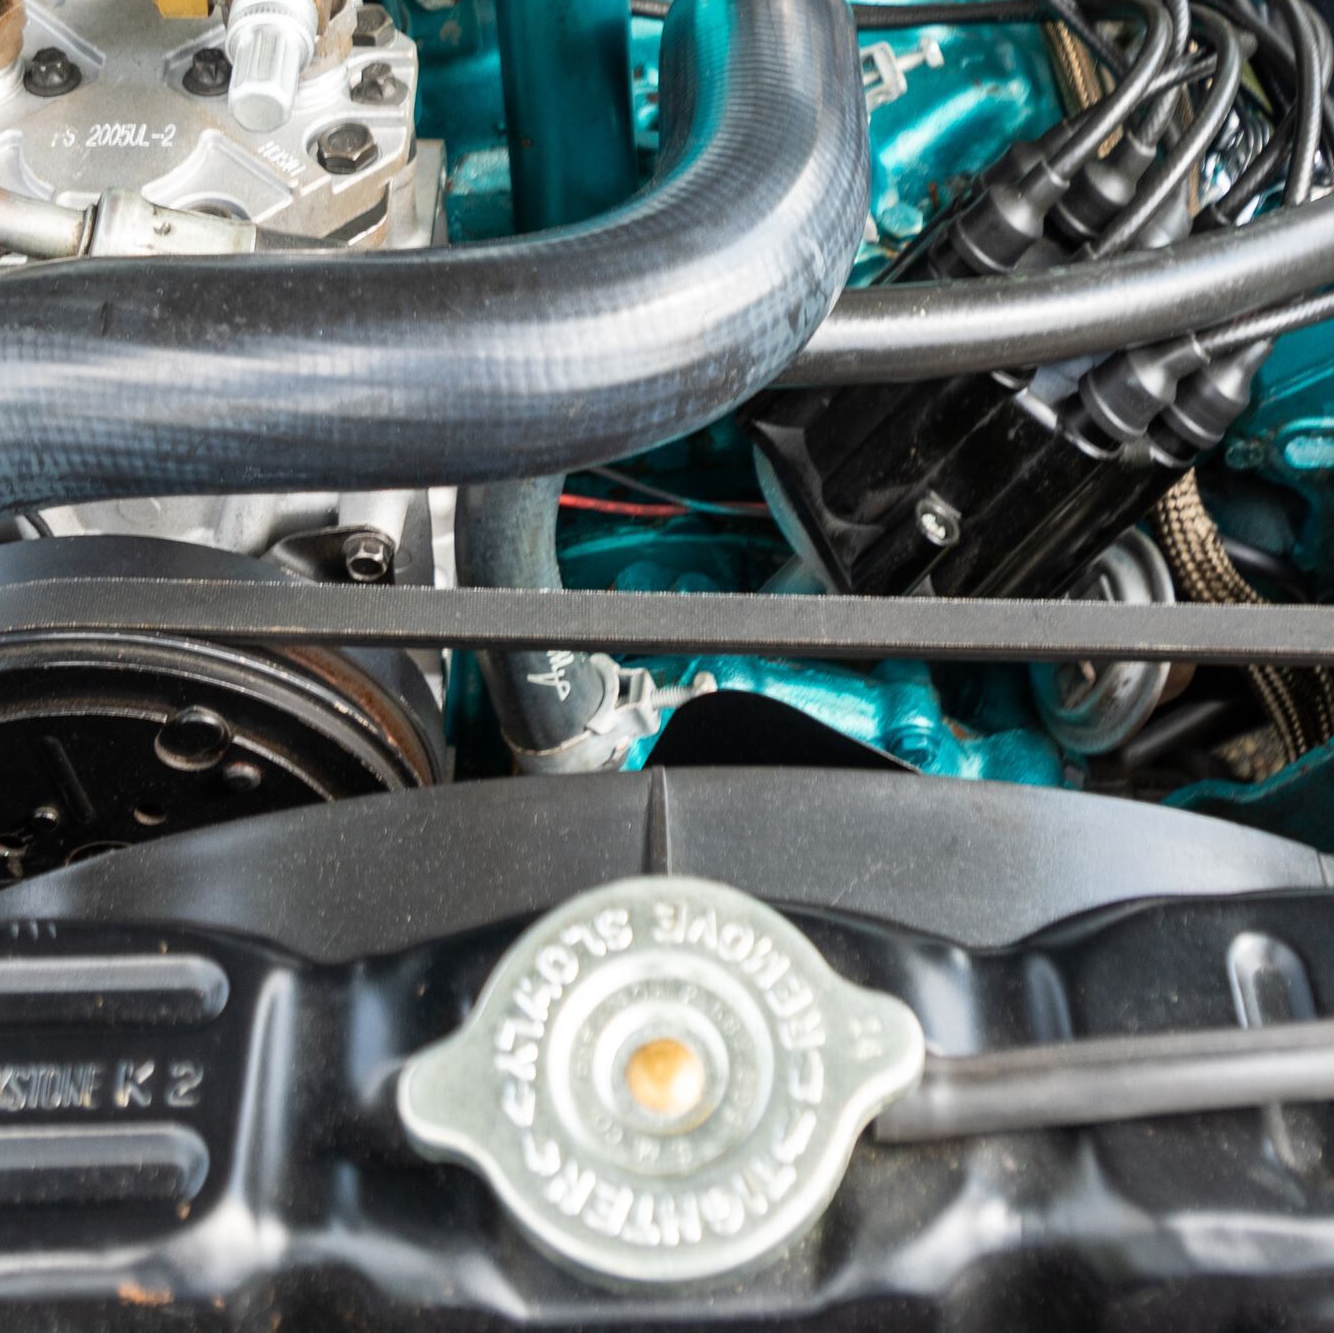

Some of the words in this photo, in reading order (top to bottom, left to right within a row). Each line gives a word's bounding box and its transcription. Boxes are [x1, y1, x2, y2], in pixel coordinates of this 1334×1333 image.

[494, 907, 634, 1082] SLOWLY
[652, 899, 826, 1051] REMOVE
[164, 1061, 205, 1108] 2
